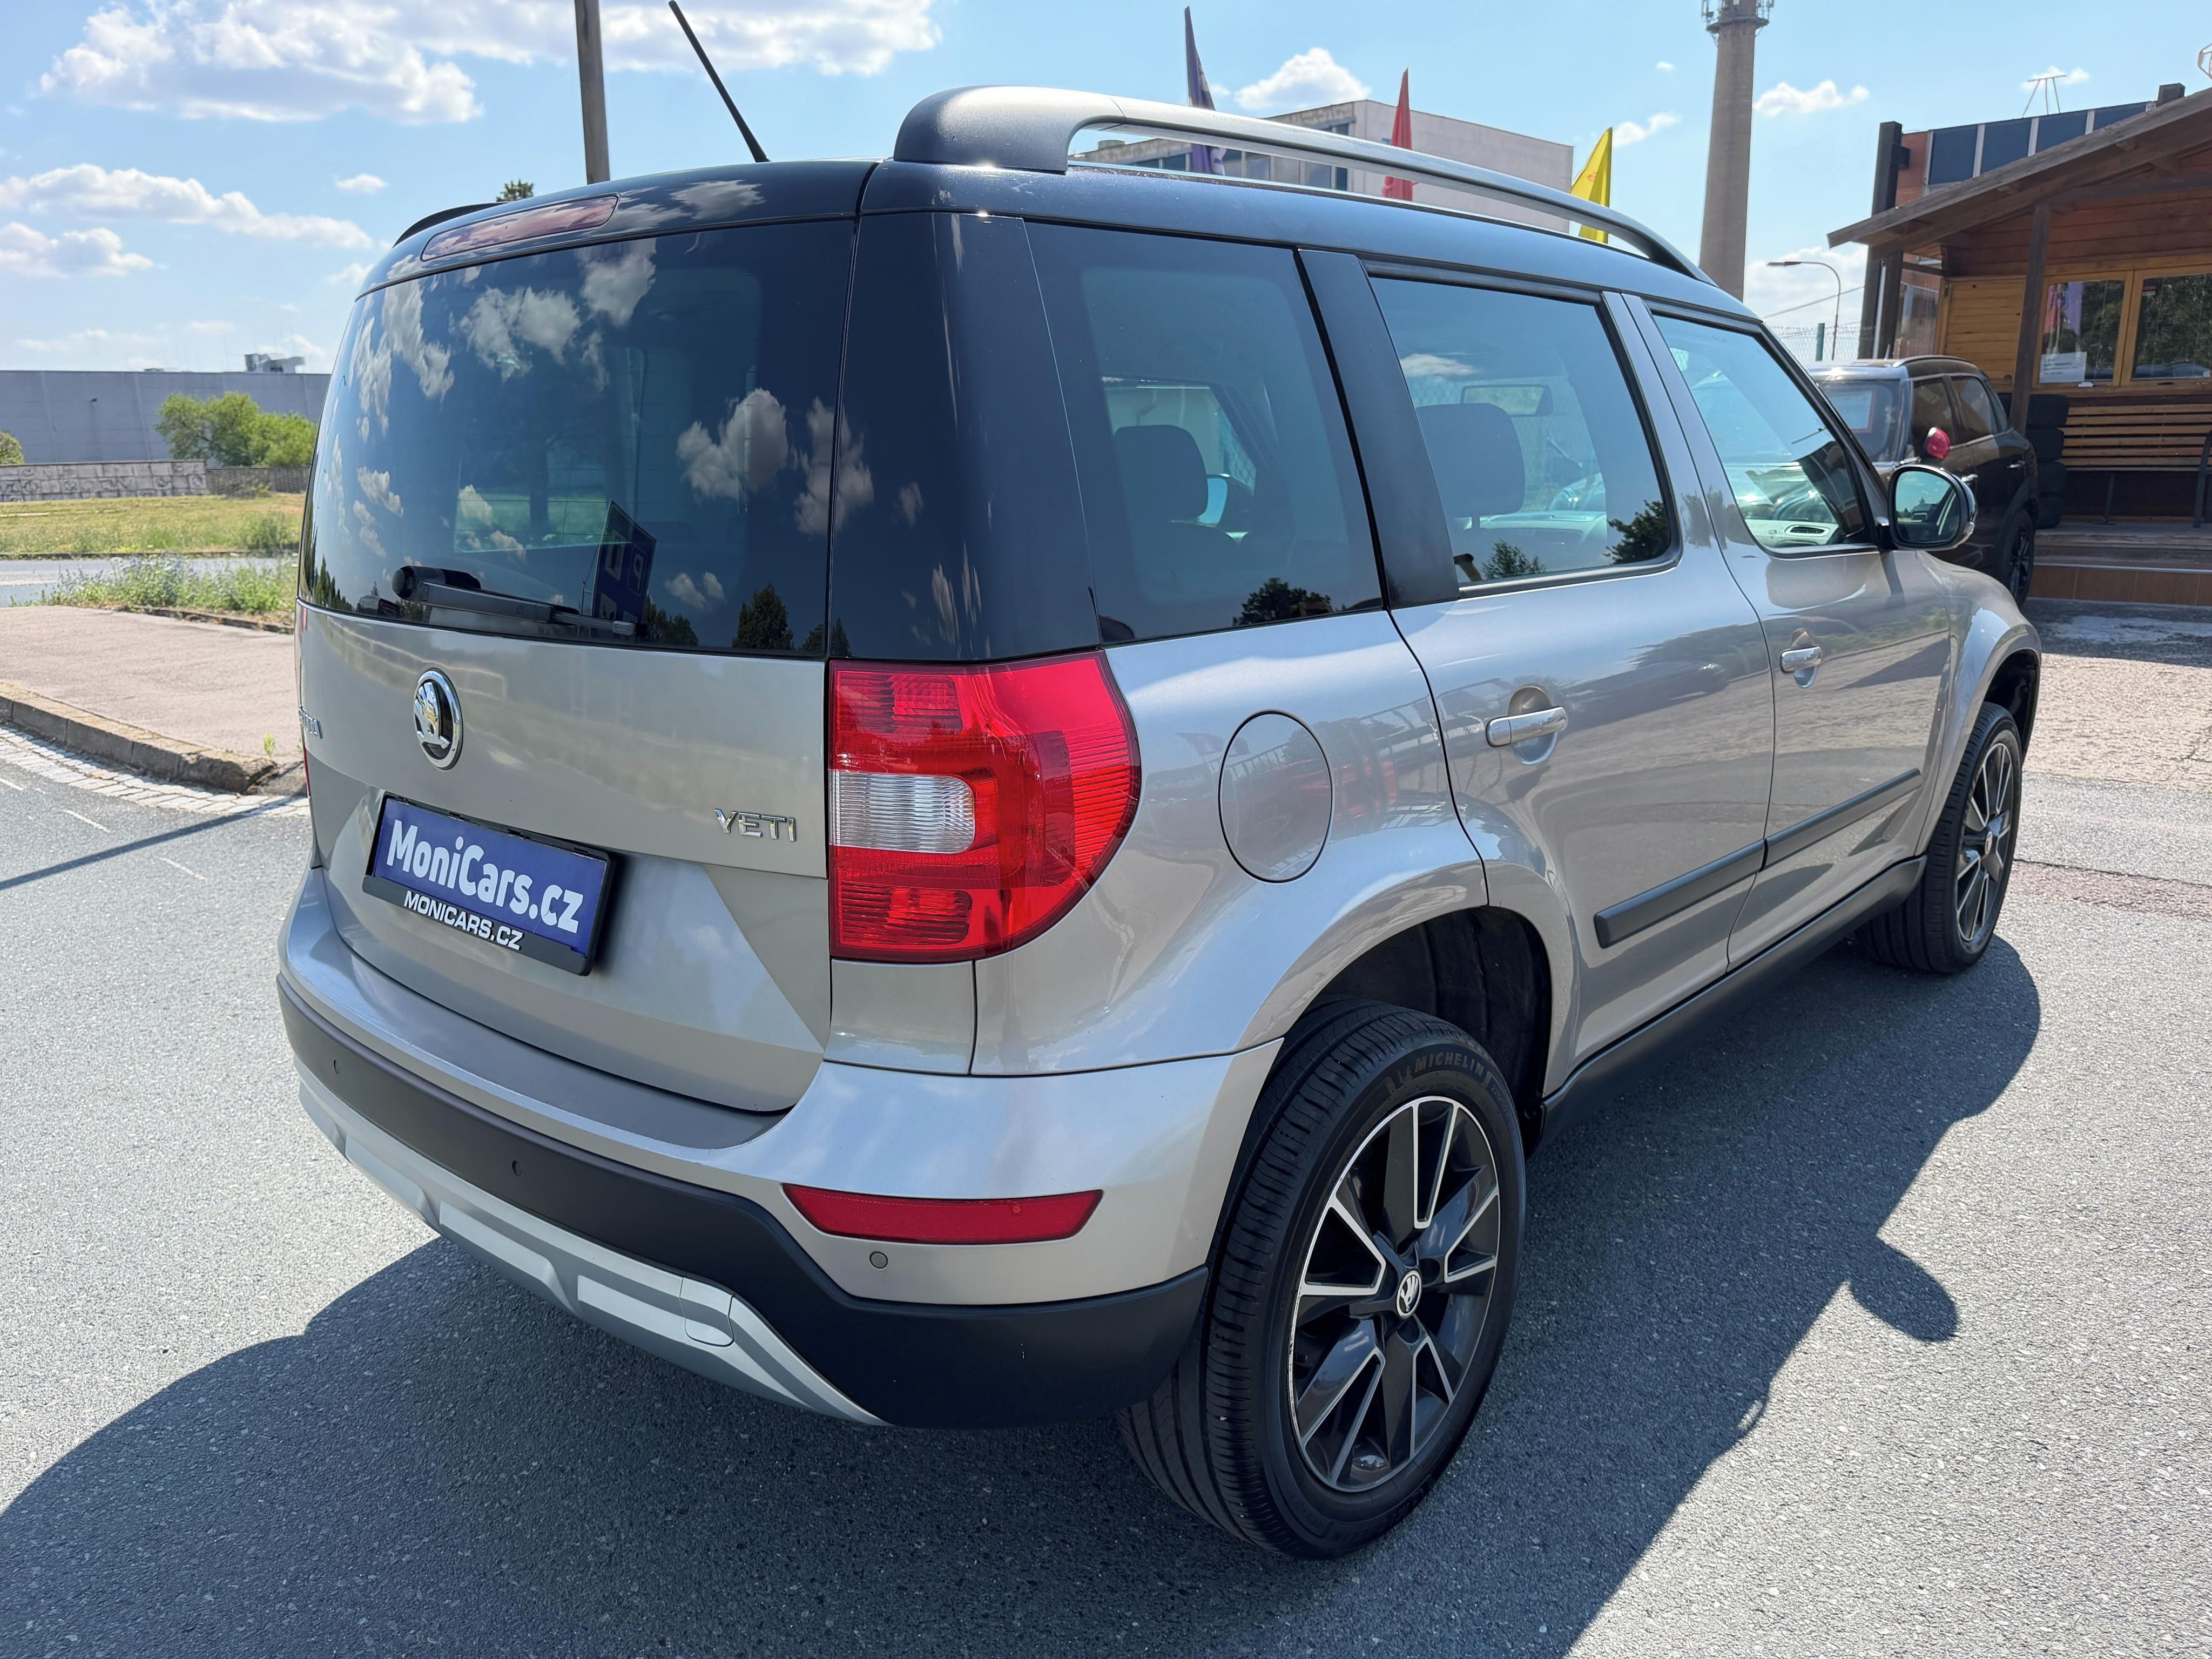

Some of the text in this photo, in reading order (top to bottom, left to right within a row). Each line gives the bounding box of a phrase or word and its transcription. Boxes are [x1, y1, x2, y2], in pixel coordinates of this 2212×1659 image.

[713, 808, 796, 842] YETI
[387, 819, 584, 934] MoniCars.cz
[403, 890, 524, 950] MONICARS.CZ
[1414, 1051, 1485, 1076] MICHELIN
